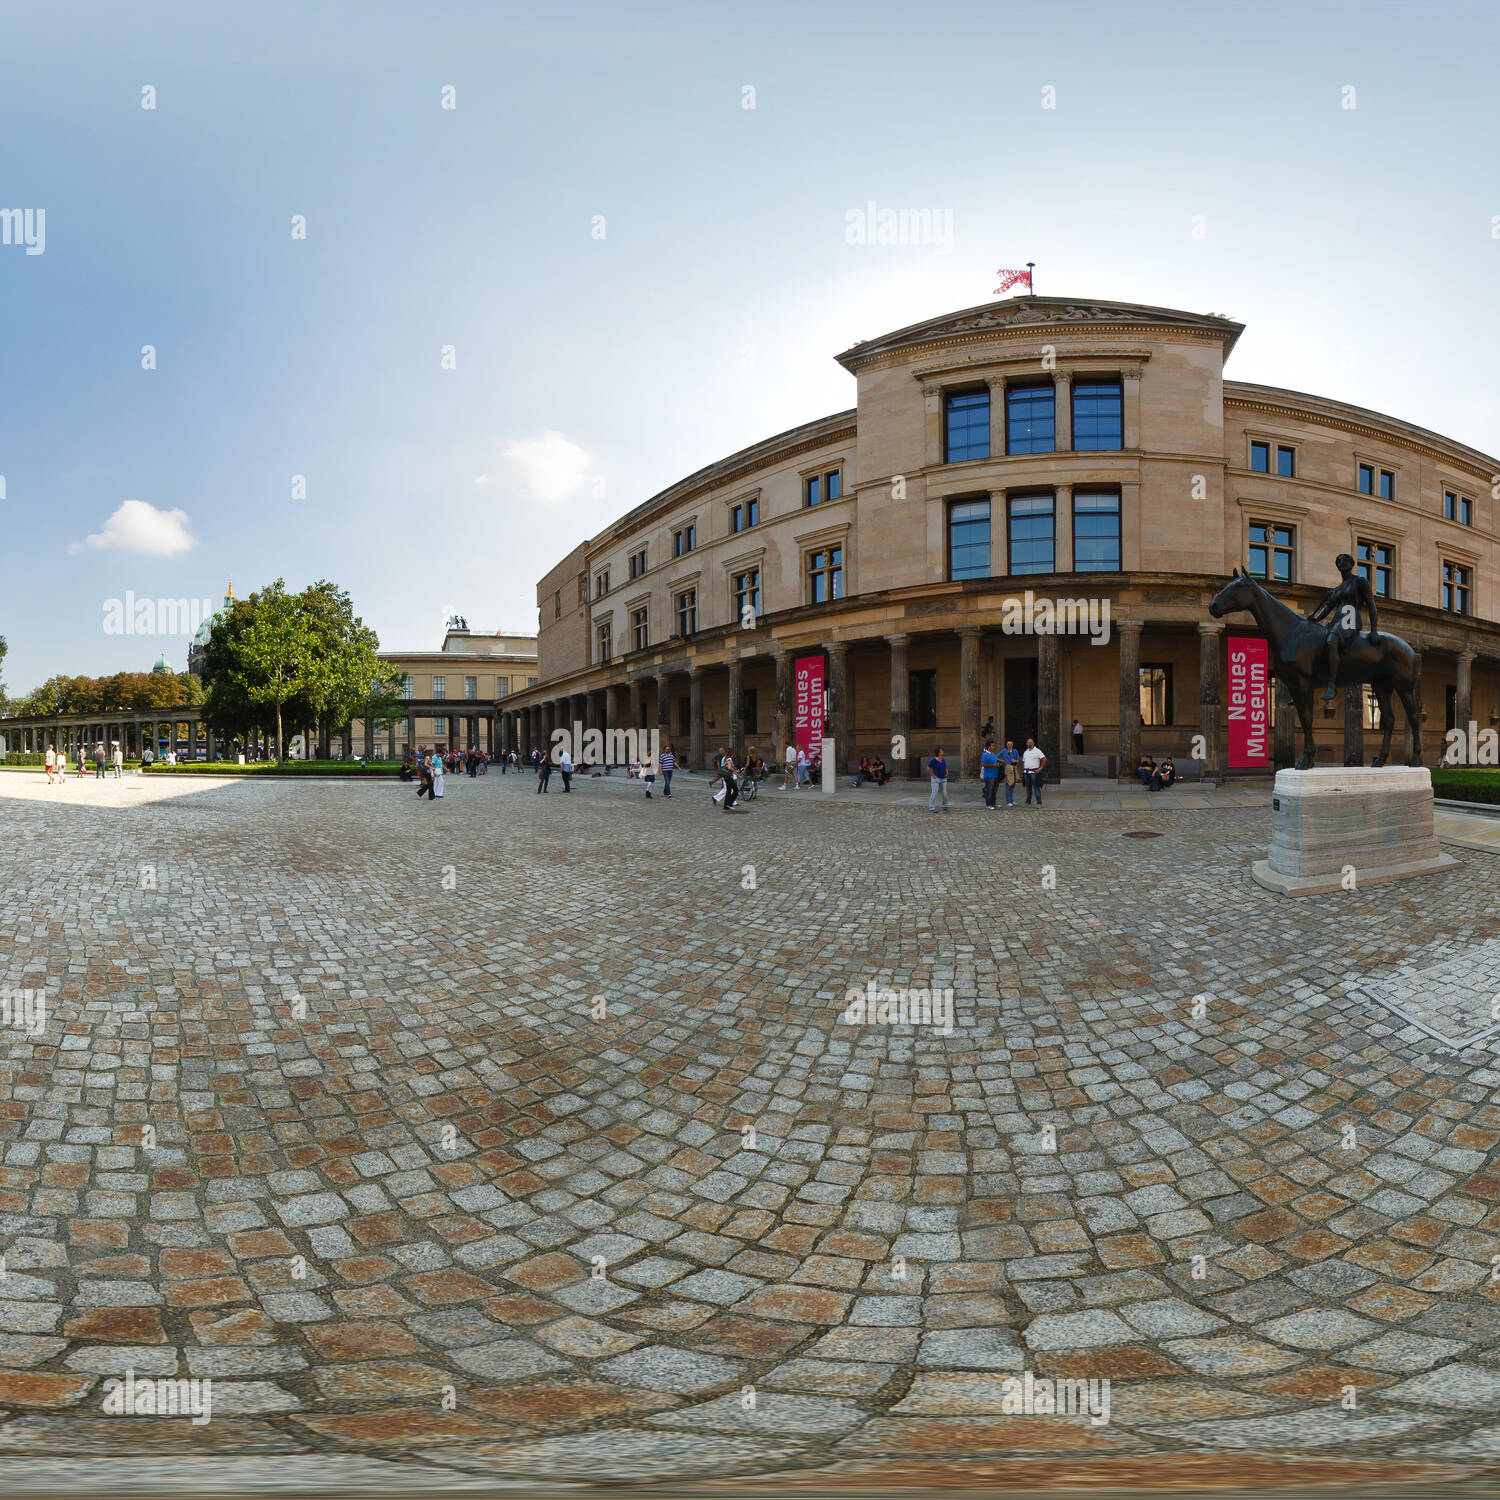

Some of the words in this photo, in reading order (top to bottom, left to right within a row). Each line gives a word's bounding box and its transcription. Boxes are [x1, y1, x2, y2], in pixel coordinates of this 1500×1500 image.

[796, 670, 809, 728] Neues
[808, 677, 822, 759] Museum
[1228, 651, 1246, 720] Neues
[1247, 663, 1265, 757] Museum
